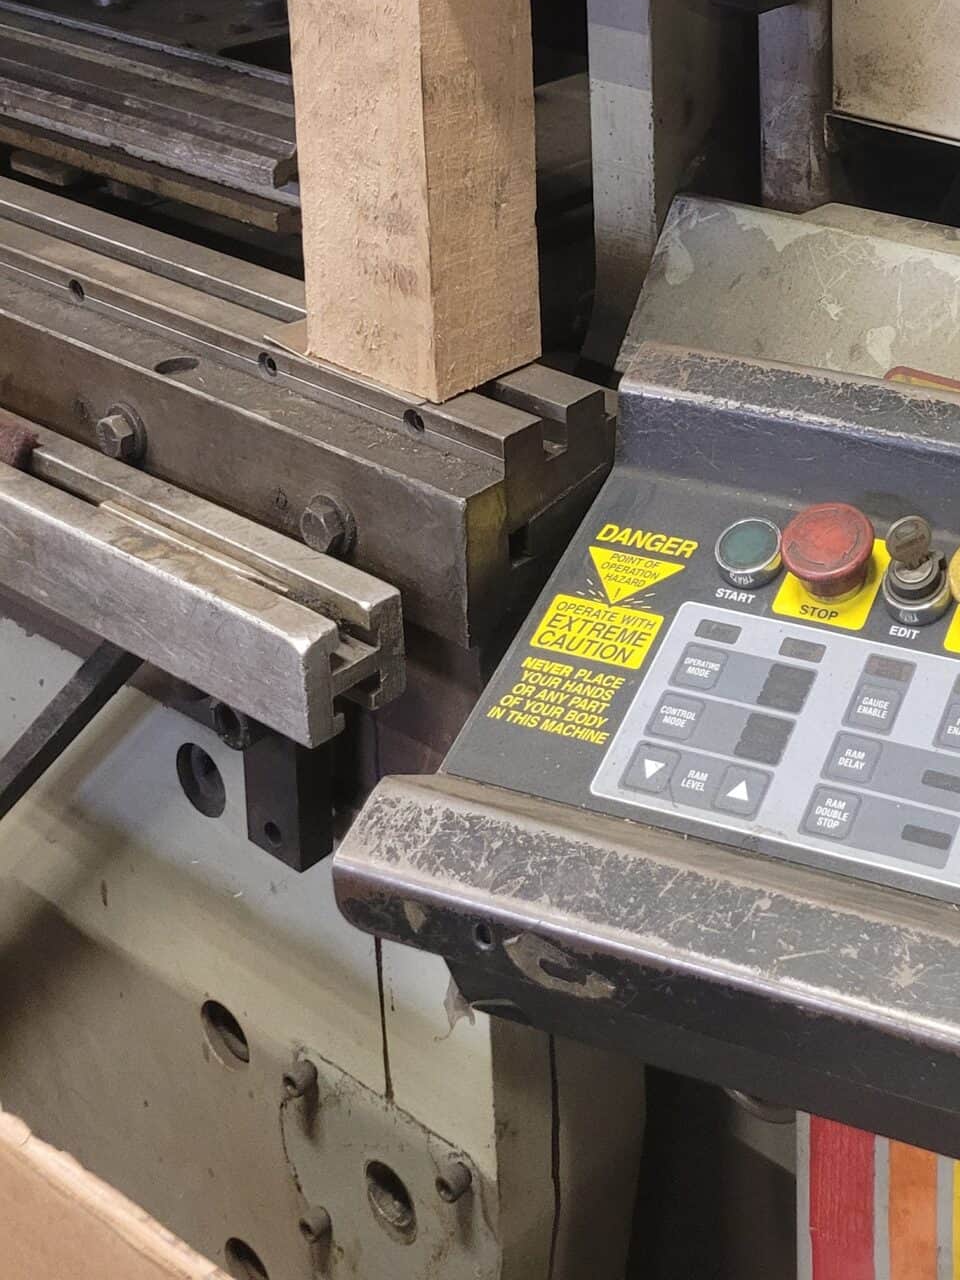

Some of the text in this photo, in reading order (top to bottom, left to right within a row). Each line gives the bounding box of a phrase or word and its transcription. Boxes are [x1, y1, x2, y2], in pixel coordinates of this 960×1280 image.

[596, 523, 698, 559] DANGER
[610, 552, 659, 569] POINT OF
[600, 562, 660, 580] OPERATION
[603, 572, 646, 588] HAZARD
[715, 588, 755, 605] START
[556, 601, 656, 630] OPERATE WITH
[799, 604, 839, 621] STOP
[546, 613, 651, 648] EXTREME
[889, 625, 920, 641] EDIT
[537, 631, 634, 663] CAUTION
[684, 657, 721, 672] OPERATING
[686, 665, 711, 678] MODE
[521, 657, 625, 690] NEVER PLACE
[521, 671, 615, 701] YOUR HANDS
[511, 683, 610, 714] OR ANY PART
[861, 696, 890, 710] GAUGE
[499, 695, 609, 729] OF YOUR BODY
[660, 705, 696, 721] CONTROL
[856, 705, 889, 719] ENABLE
[487, 706, 610, 745] IN THIS MACHINE
[662, 715, 687, 728] MODE
[844, 749, 866, 760] RAM
[838, 757, 866, 770] DELAY
[687, 769, 708, 782] RAM
[681, 779, 705, 792] LEVEL
[825, 798, 847, 810] RAM
[815, 806, 849, 821] DOUBLE
[816, 817, 840, 829] STOP
